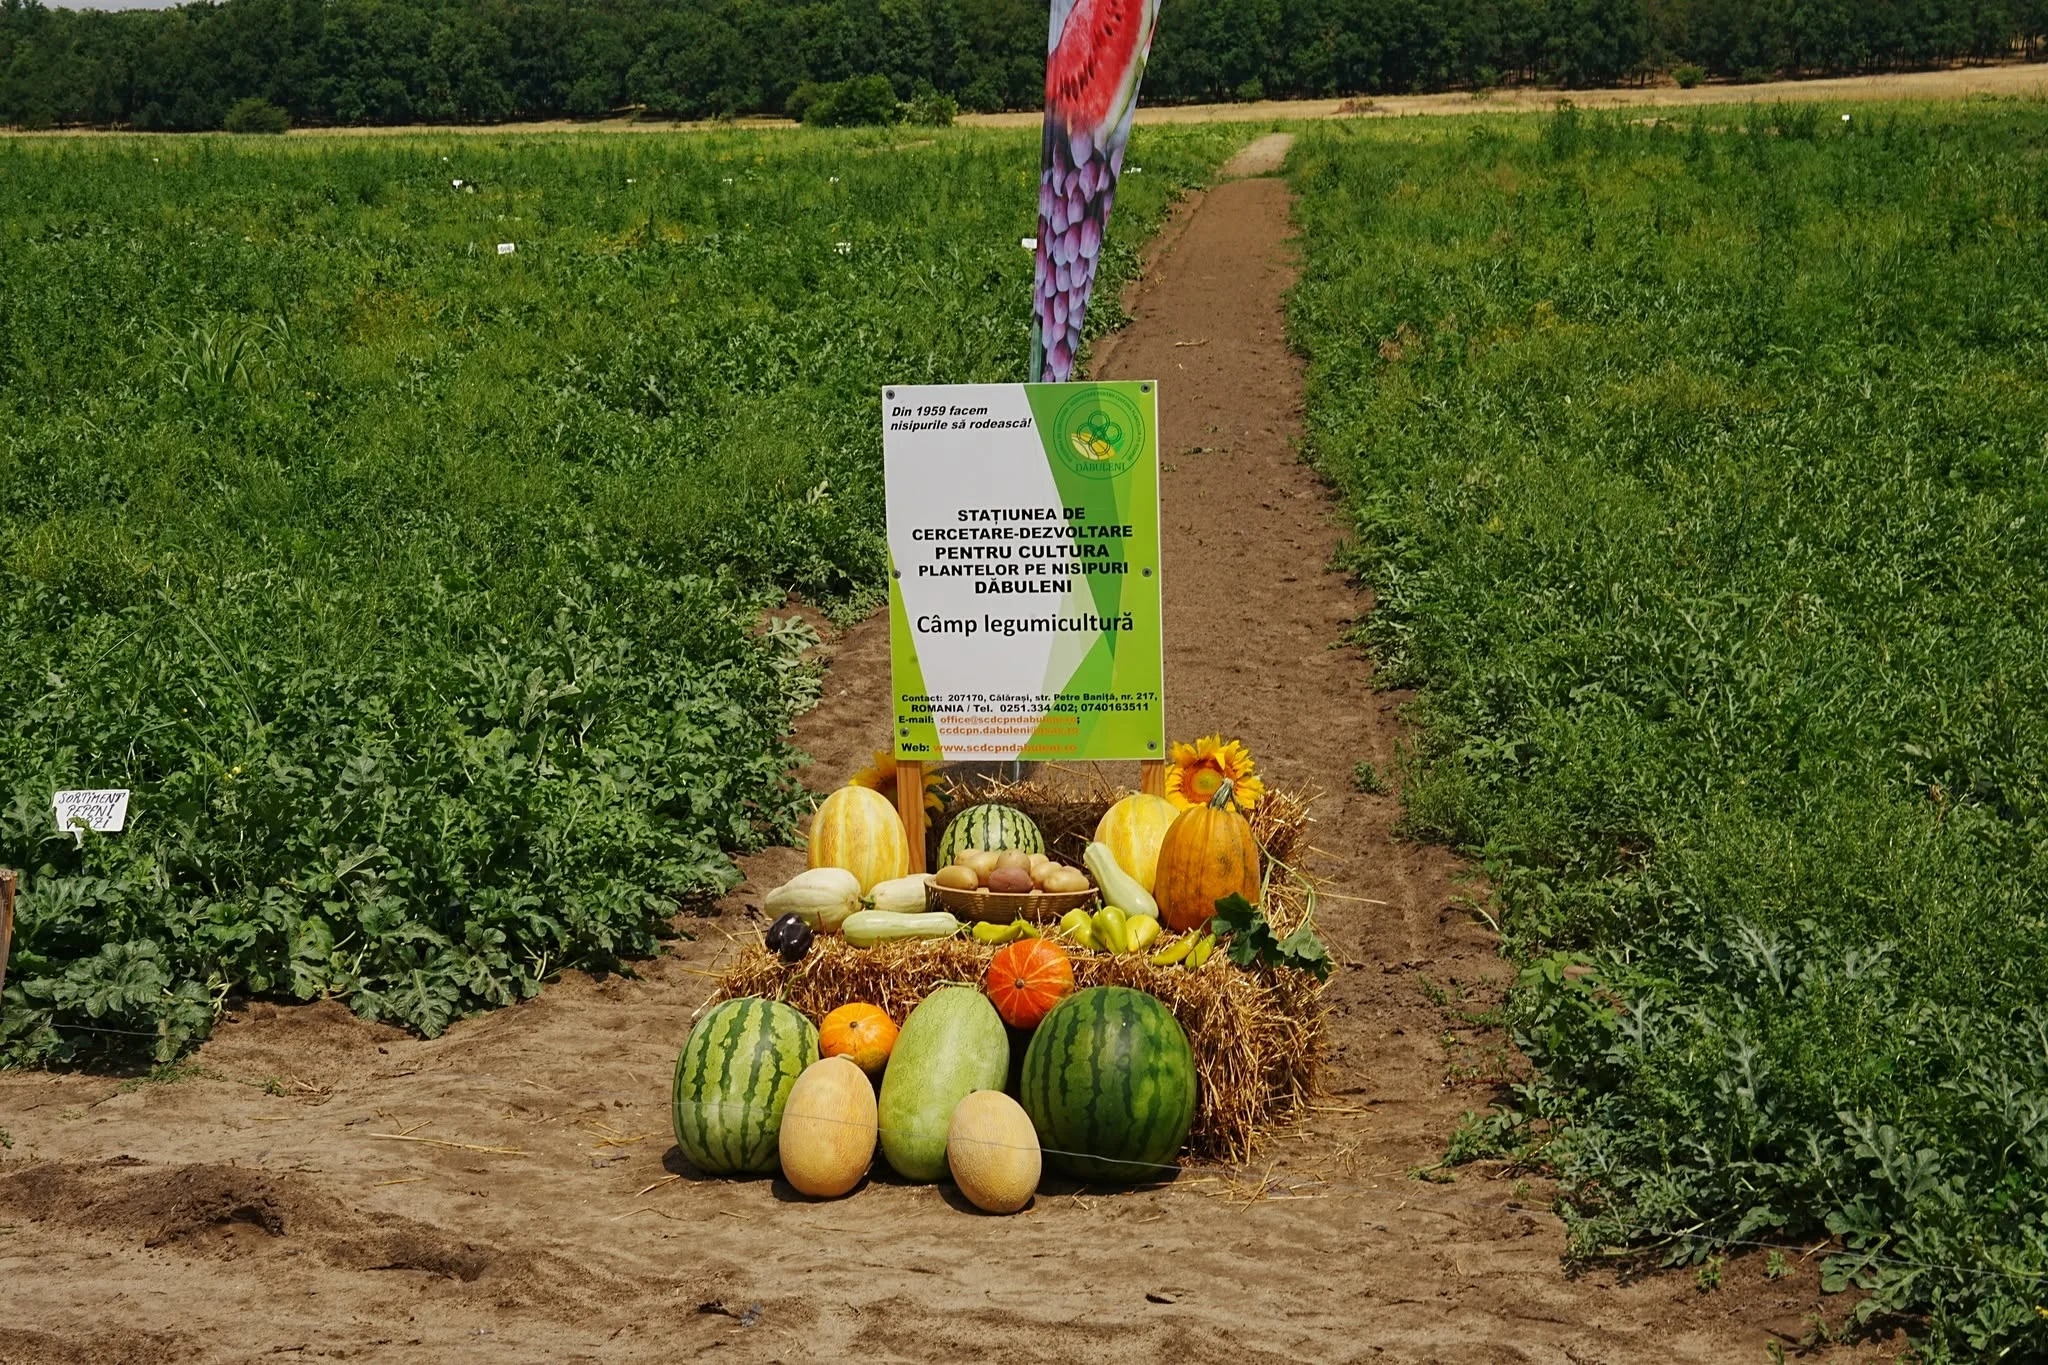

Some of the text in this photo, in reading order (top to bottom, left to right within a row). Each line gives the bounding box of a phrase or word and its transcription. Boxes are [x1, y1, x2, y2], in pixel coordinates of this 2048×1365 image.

[892, 405, 988, 417] Din 1959 facem
[890, 417, 1031, 431] nisipurile să rodească!
[1063, 507, 1085, 520] DE
[912, 525, 1133, 540] CERCETARE-DEZVOLTARE
[935, 544, 1109, 559] PENTRU CULTURA
[918, 562, 1128, 577] PLANTELOR PE NISIPURI
[975, 578, 1072, 594] DĂBULENI
[917, 611, 1133, 637] Câmp legumicultură
[948, 694, 986, 702] 207170,
[1054, 693, 1080, 701] Petre
[1136, 692, 1158, 701] 217,
[911, 705, 963, 713] ROMANIA
[973, 704, 993, 712] Tel.
[1000, 703, 1050, 712] 0251.334
[1054, 703, 1078, 713] 402;
[1080, 702, 1149, 712] 0740163511
[899, 716, 934, 724] E-mail:
[901, 743, 929, 752] Web:
